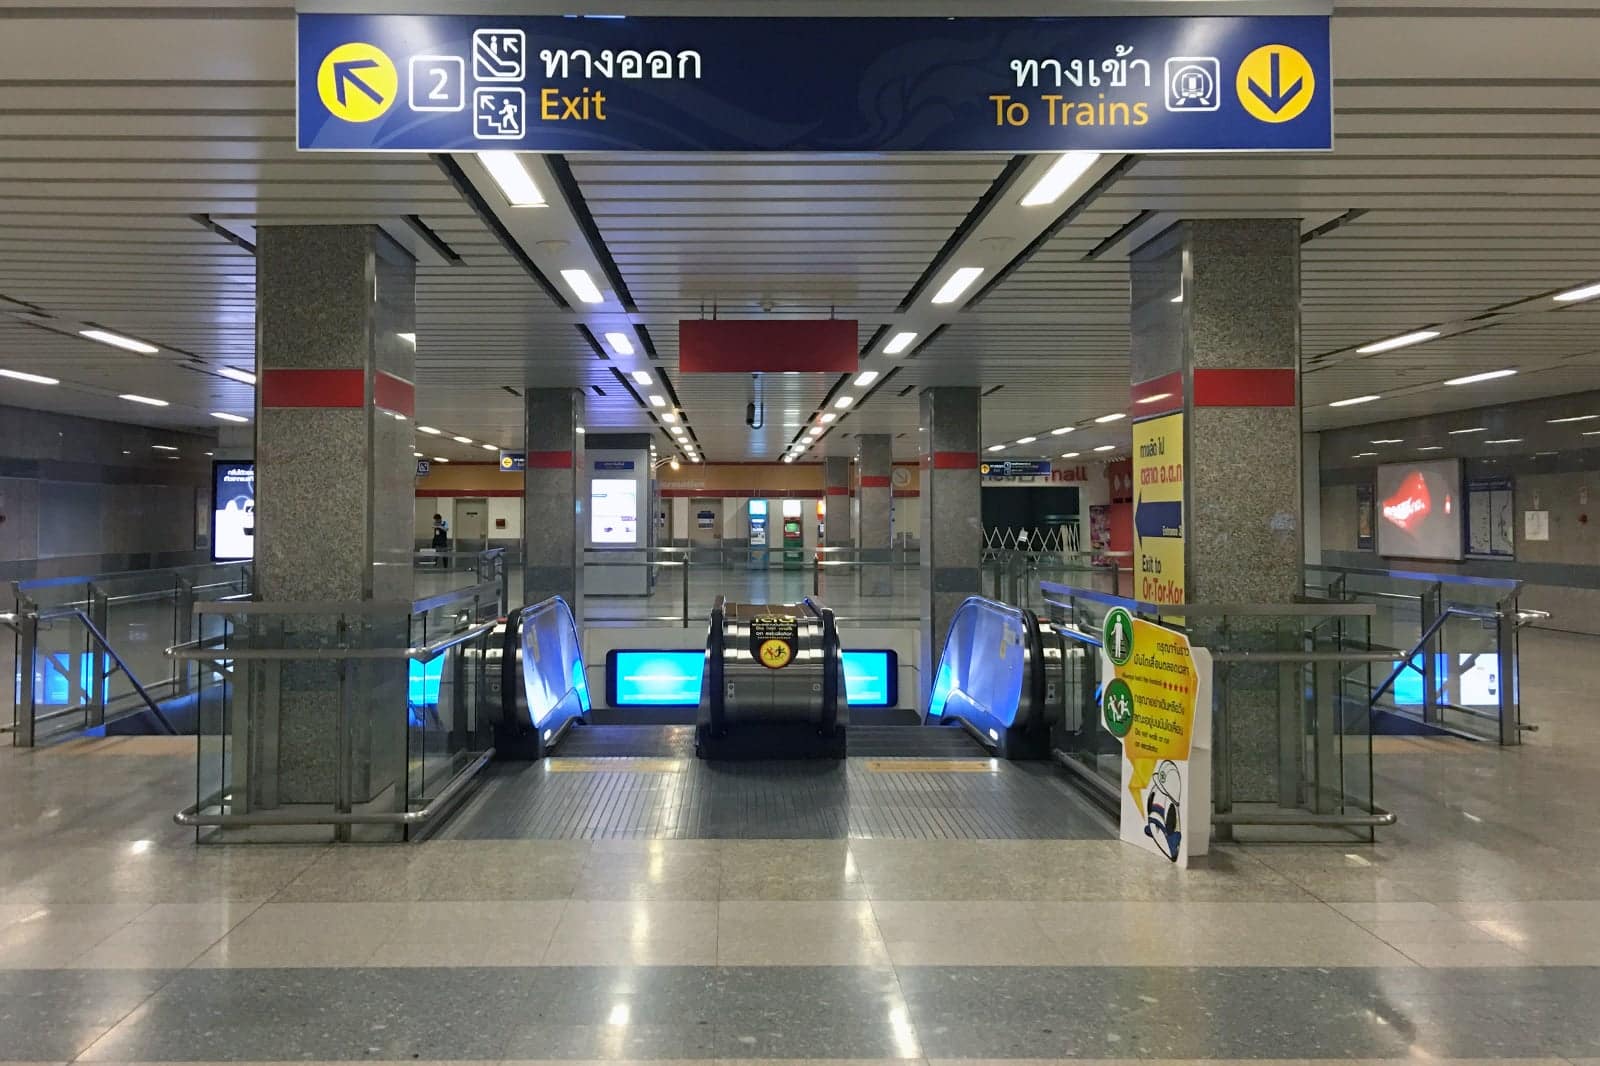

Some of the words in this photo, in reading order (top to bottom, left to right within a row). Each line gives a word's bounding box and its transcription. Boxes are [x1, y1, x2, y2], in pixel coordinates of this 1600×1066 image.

[540, 48, 701, 79] ทางออก
[1010, 44, 1151, 87] ทางเข้า
[428, 67, 448, 100] 2
[540, 88, 606, 120] Exit
[988, 95, 1030, 126] To
[1041, 93, 1149, 127] Trains
[1142, 554, 1154, 573] Exit
[1154, 557, 1162, 574] to
